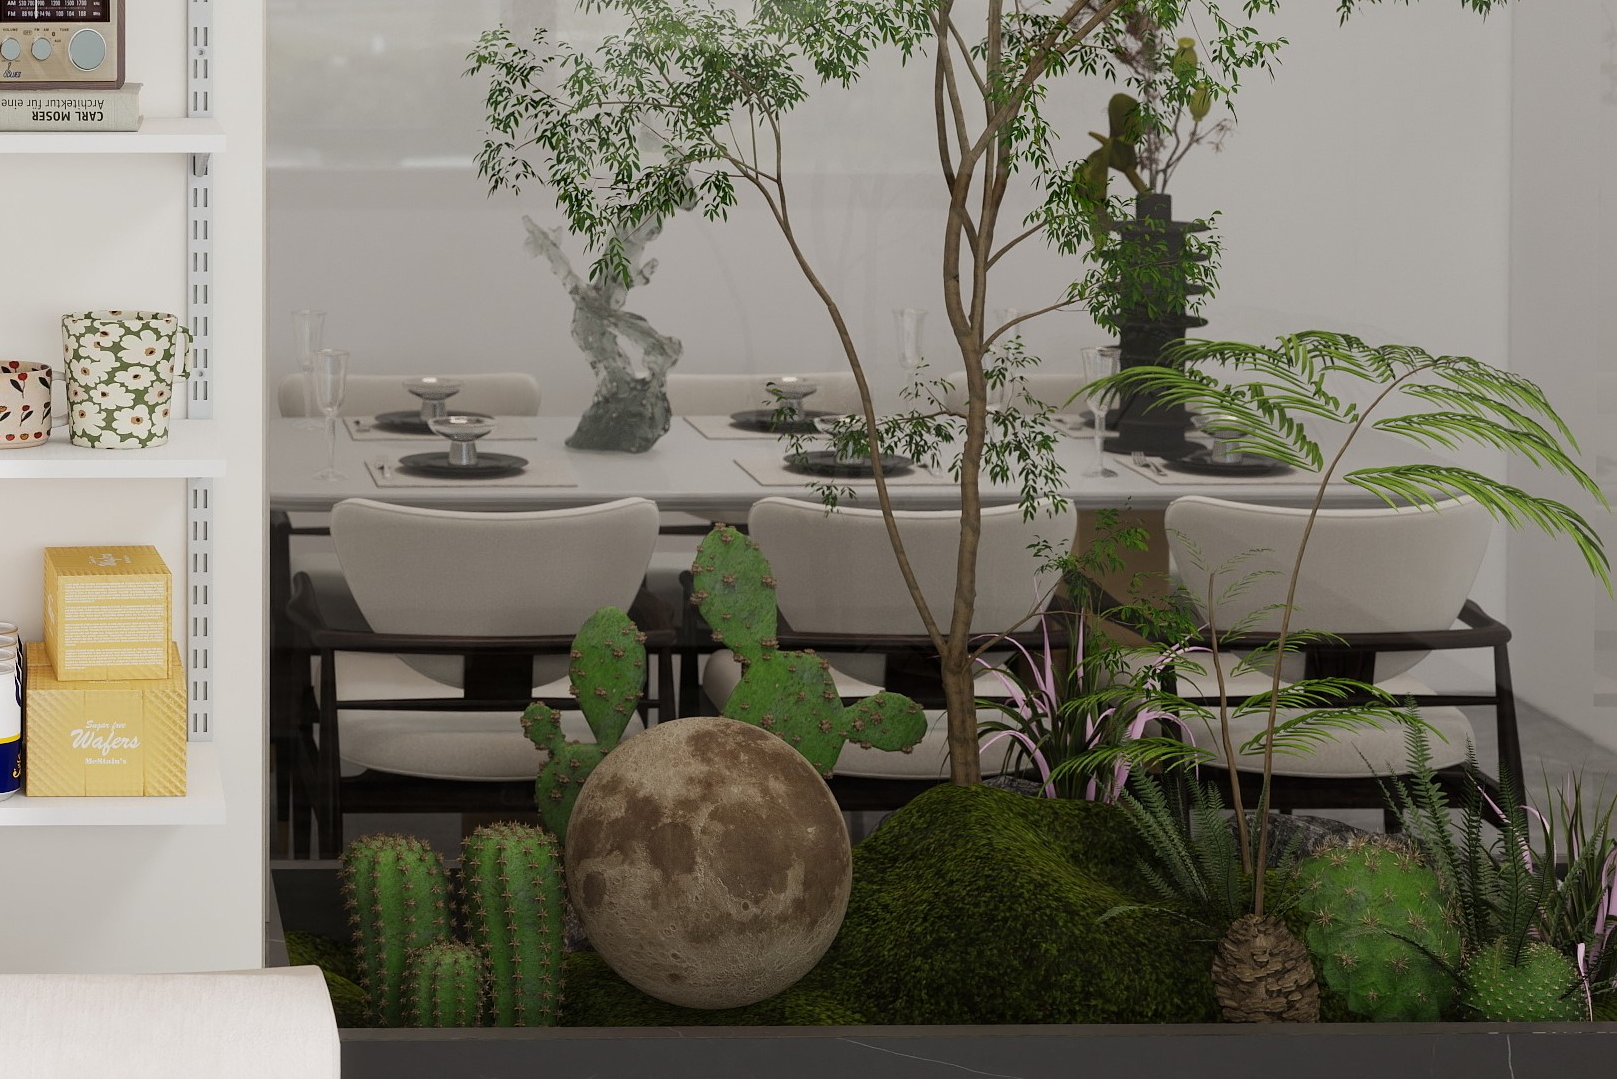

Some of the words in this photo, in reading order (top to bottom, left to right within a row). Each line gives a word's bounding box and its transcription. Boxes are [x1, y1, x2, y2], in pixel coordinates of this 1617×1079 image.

[1, 99, 22, 109] eine
[26, 99, 41, 109] für
[45, 99, 103, 109] Architektur
[31, 111, 70, 121] MOSER
[75, 111, 102, 121] CARL
[86, 720, 109, 731] Sugar
[70, 729, 140, 756] Wafers
